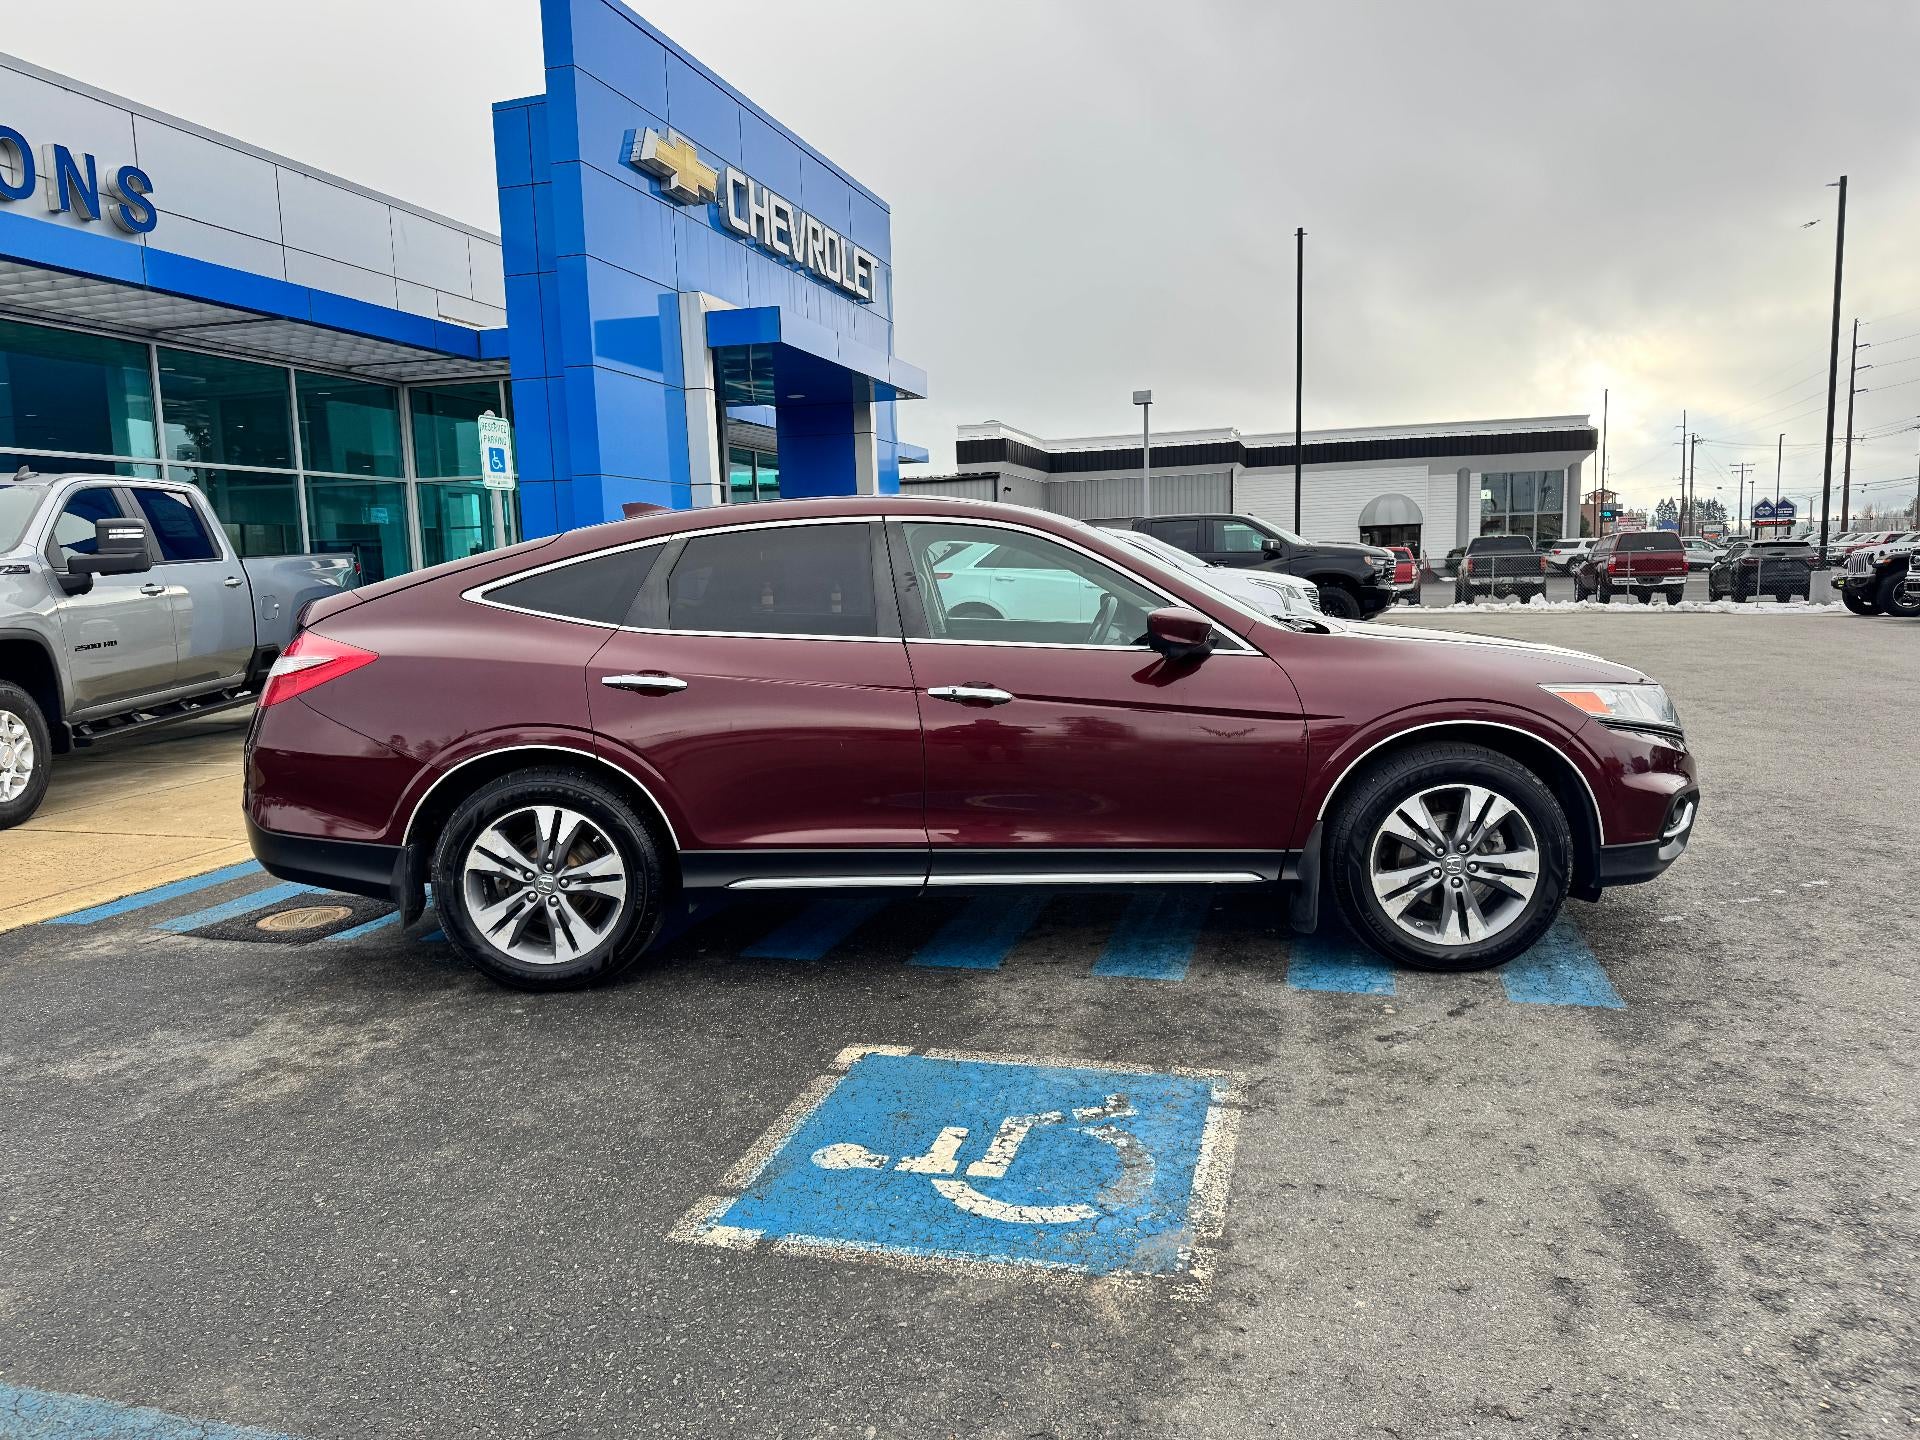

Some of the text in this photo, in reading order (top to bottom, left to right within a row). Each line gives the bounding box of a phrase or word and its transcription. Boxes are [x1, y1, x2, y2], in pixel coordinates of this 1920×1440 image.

[723, 166, 879, 303] CHEVROLET
[483, 434, 507, 446] PARKING
[74, 642, 102, 652] 2500
